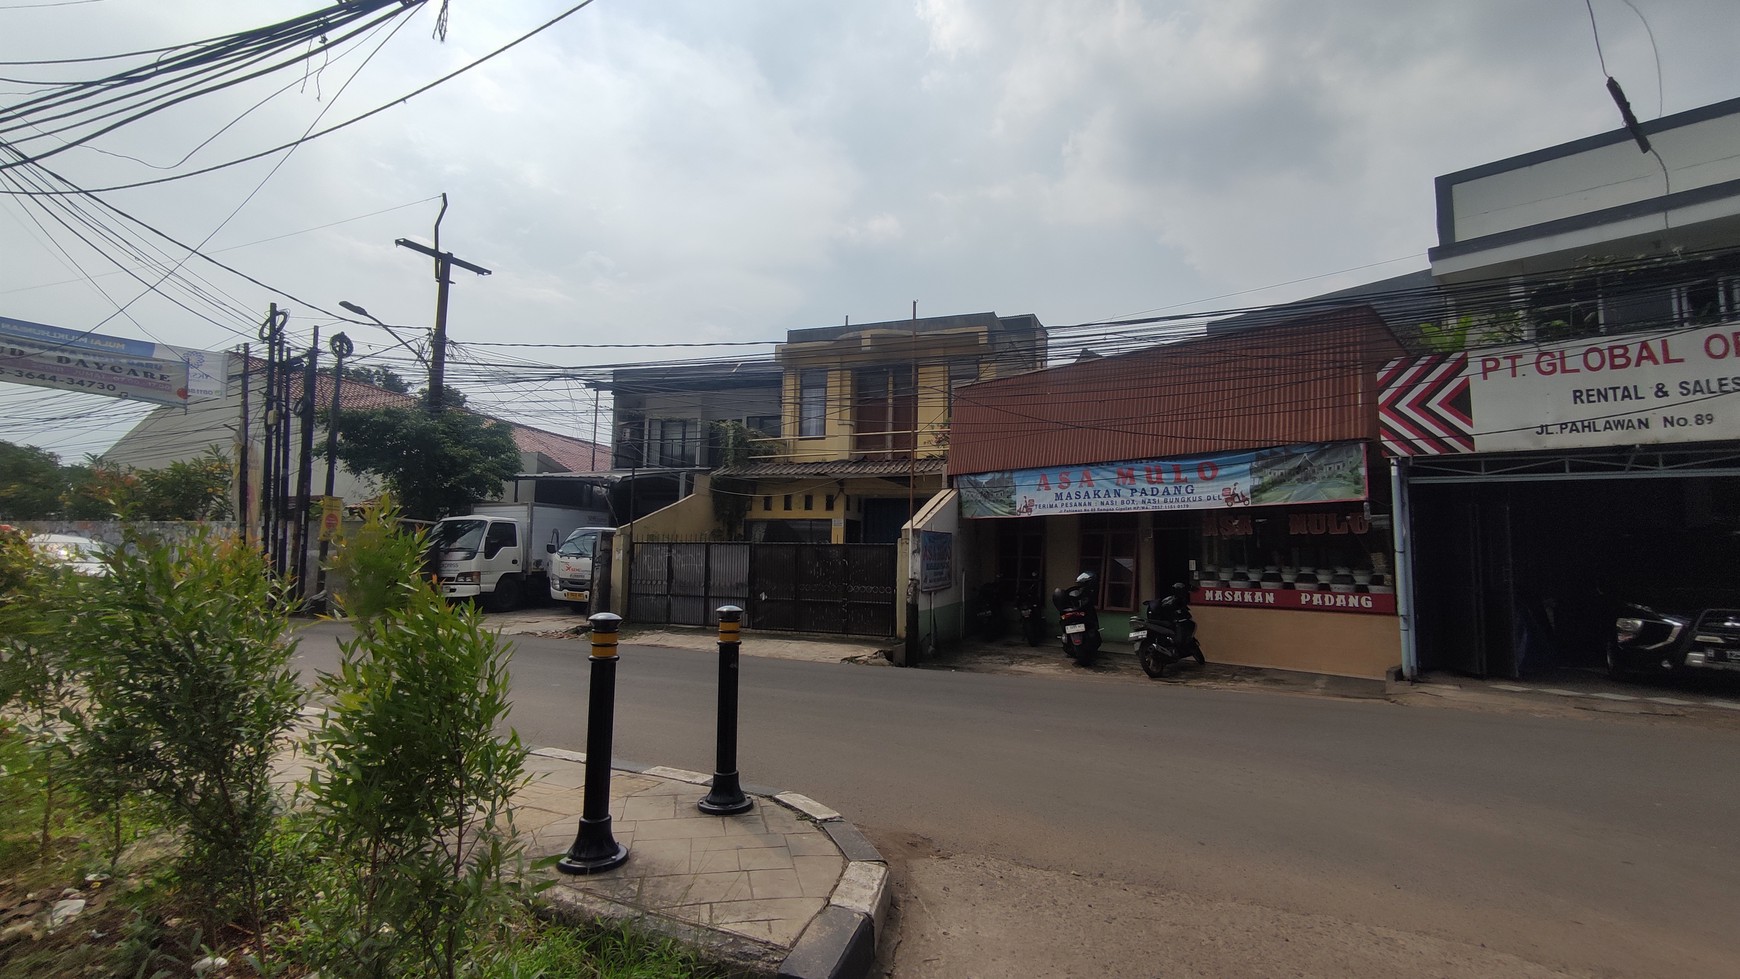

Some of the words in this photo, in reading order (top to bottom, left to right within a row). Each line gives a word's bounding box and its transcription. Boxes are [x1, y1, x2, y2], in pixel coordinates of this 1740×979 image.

[56, 355, 171, 382] DAYCARE
[1572, 384, 1645, 405] RENTAL
[1654, 383, 1669, 398] &
[1036, 468, 1095, 491] ASA
[1115, 461, 1219, 487] MULO
[1055, 488, 1122, 501] MASAKAN
[1130, 484, 1195, 497] PADANG
[1164, 495, 1202, 503] BUNGKUS
[1205, 589, 1275, 604] MASAKAN
[1301, 592, 1373, 608] PADANG
